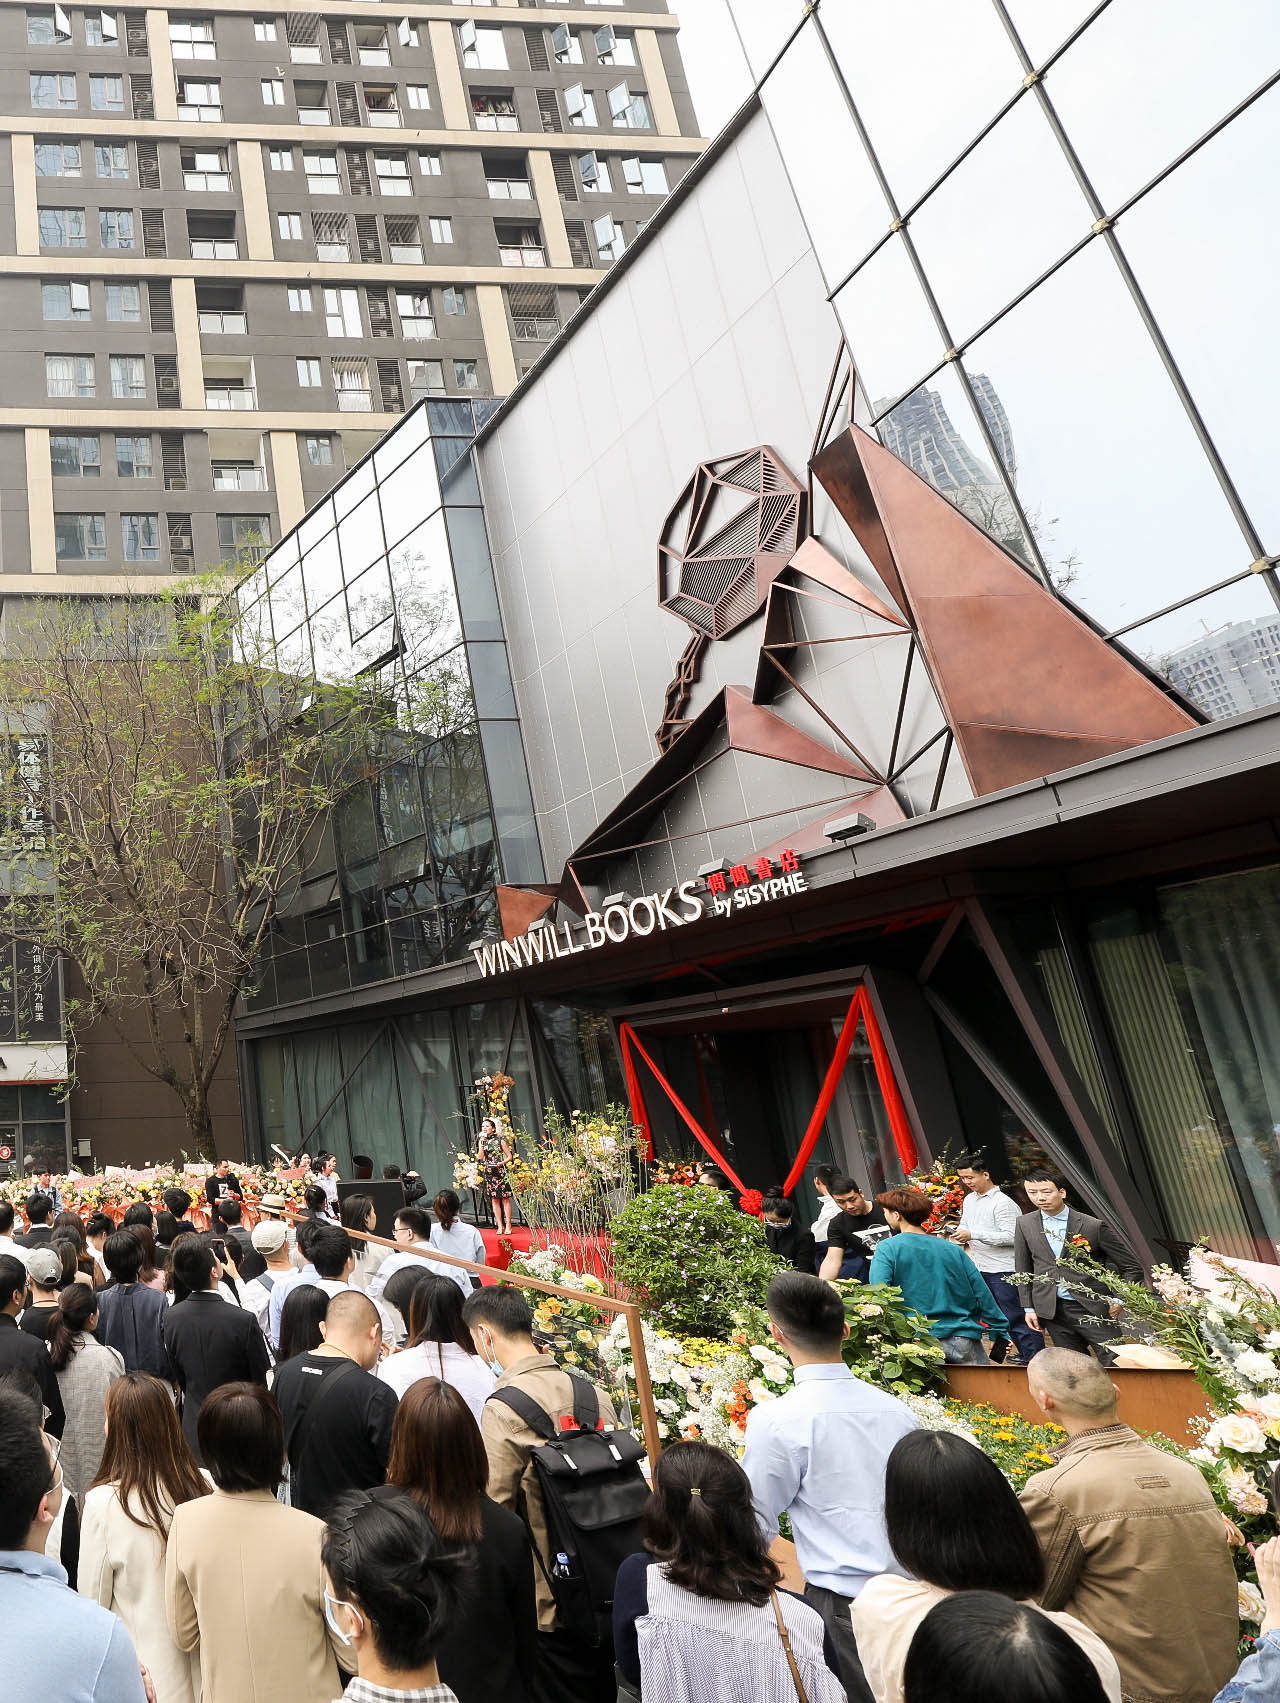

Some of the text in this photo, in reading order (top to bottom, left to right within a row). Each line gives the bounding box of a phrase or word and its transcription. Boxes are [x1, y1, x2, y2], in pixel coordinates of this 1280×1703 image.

[473, 920, 584, 978] WINWILL
[584, 880, 703, 949] BOOKS
[713, 895, 732, 918] by
